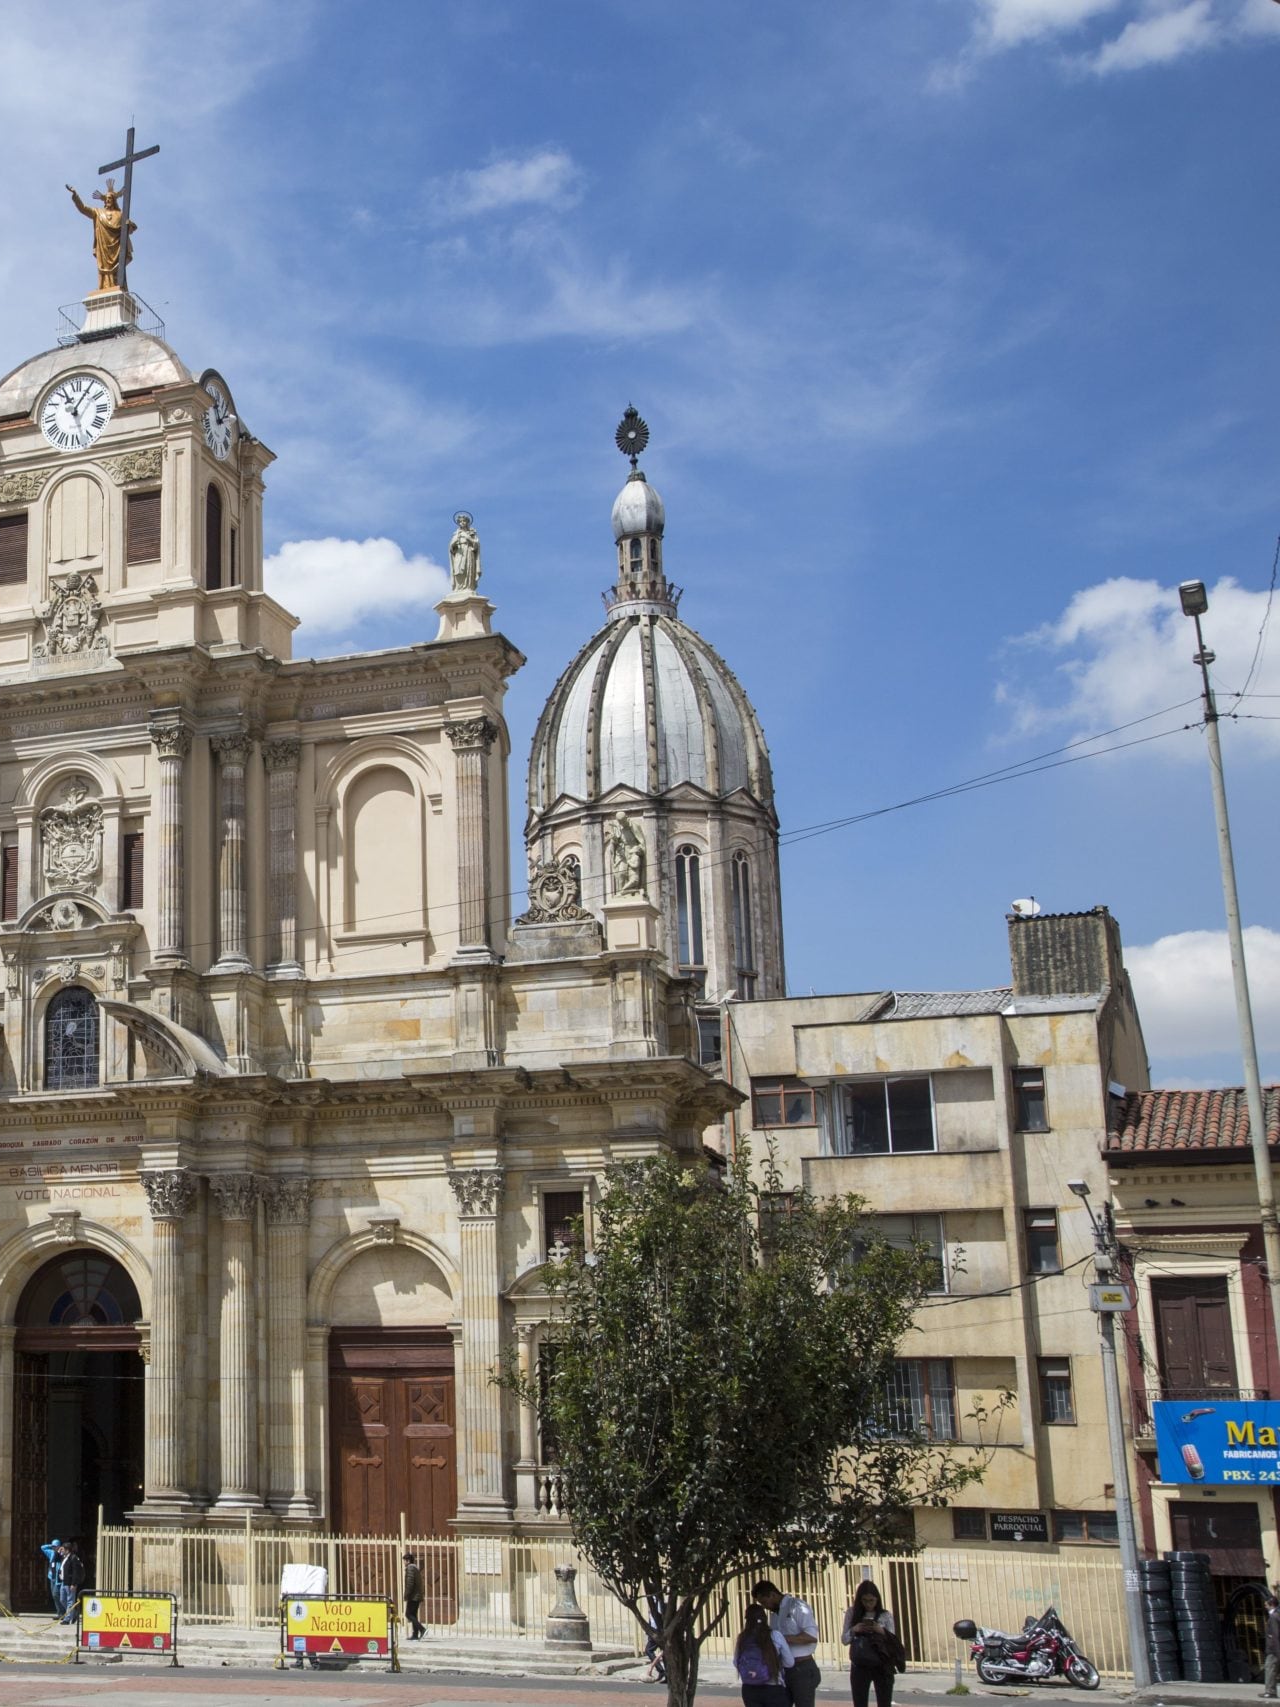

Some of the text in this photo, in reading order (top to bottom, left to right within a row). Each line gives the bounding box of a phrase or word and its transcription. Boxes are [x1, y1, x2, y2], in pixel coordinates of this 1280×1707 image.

[32, 1140, 62, 1148] SAGRADO
[70, 1164, 118, 1175] MENOR
[16, 1186, 120, 1200] VOTO NACIONAL
[1225, 1421, 1280, 1446] Ma
[1223, 1451, 1278, 1459] FABRICAMOS
[1222, 1470, 1256, 1480] PBX:
[998, 1515, 1039, 1524] DESPACHO
[994, 1523, 1044, 1532] PARROQUIAL
[116, 1598, 141, 1612] Voto
[324, 1600, 352, 1616] Voto
[104, 1612, 158, 1628] Nacional
[310, 1616, 372, 1632] Nacional
